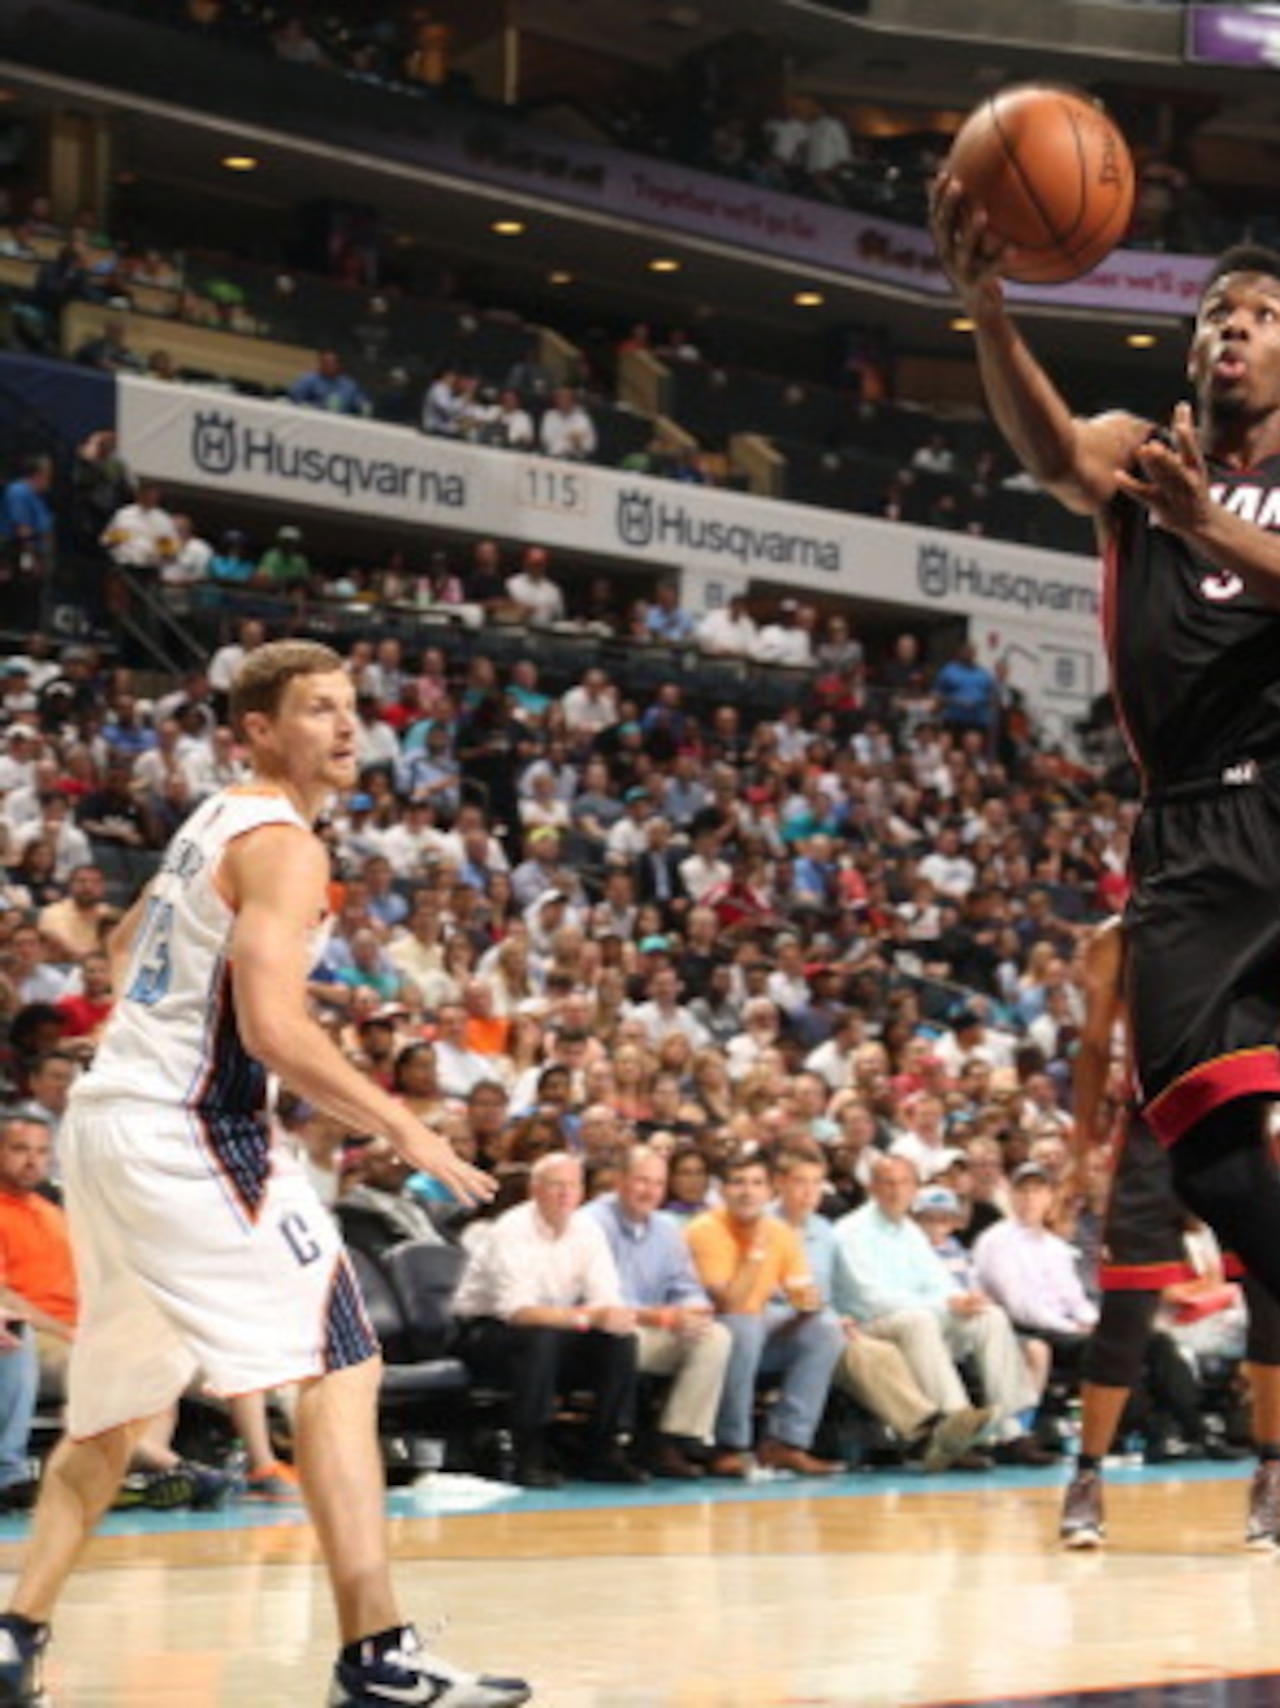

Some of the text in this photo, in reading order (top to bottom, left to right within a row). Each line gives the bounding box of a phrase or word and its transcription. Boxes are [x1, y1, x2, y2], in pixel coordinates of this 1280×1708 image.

[243, 428, 465, 507] Husqvarna
[527, 469, 578, 507] 115
[658, 503, 841, 571] Husqvarna
[954, 556, 1099, 614] Husqvarn
